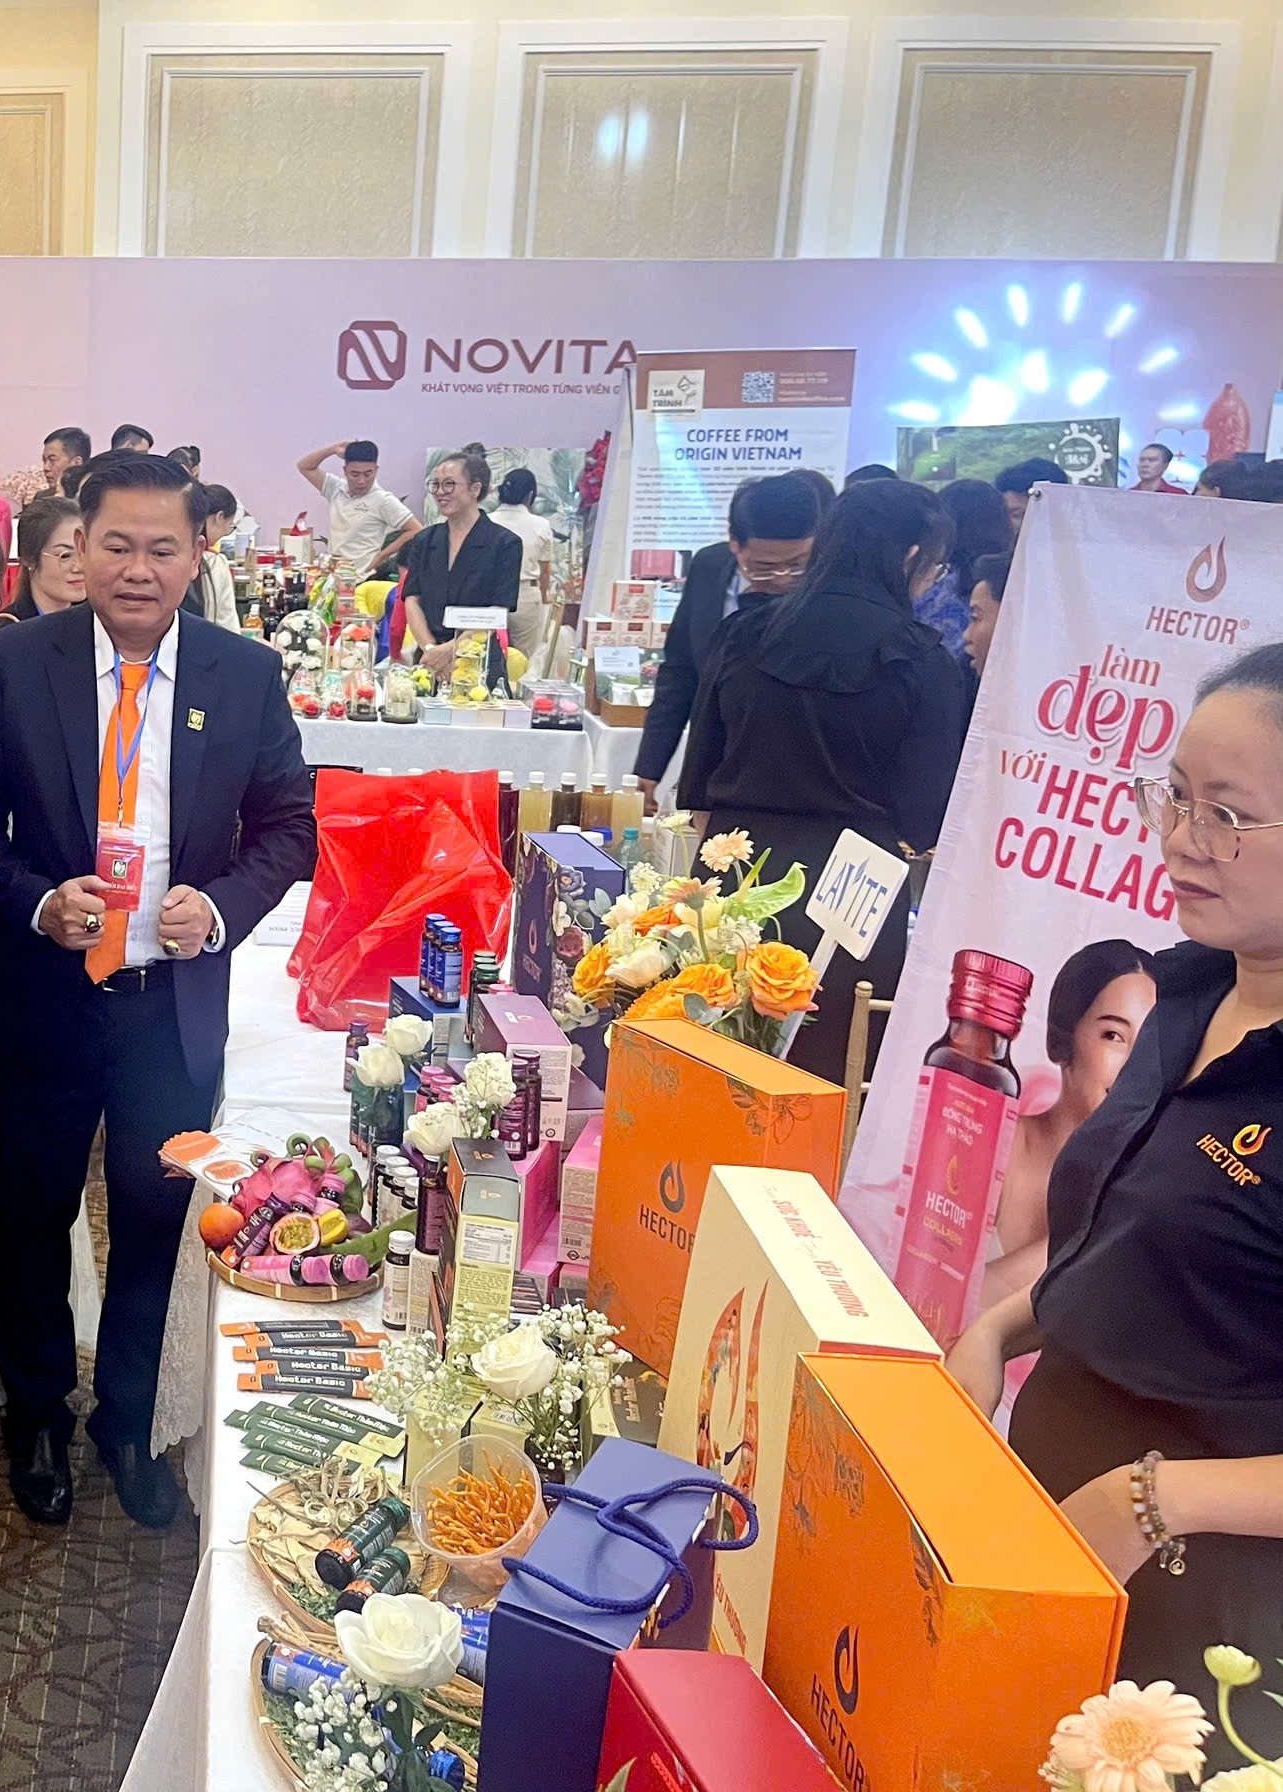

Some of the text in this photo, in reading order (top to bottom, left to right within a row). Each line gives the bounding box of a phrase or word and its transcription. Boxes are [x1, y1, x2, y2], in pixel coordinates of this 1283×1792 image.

[424, 338, 637, 375] NOVITA
[421, 382, 450, 394] KHÁT
[452, 384, 483, 397] VỌNG
[512, 385, 550, 394] TRONG
[687, 428, 789, 443] COFFEE FROM
[675, 447, 803, 461] ORIGIN VIETNAM
[1099, 644, 1161, 688] làm
[1037, 664, 1175, 771] đẹp
[1001, 749, 1149, 843] với HEC
[995, 817, 1177, 921] COLLAG
[291, 1361, 362, 1373] Hector Basic
[274, 1374, 346, 1387] Hector Basic
[330, 1404, 357, 1419] Hector
[284, 1440, 313, 1455] Hector
